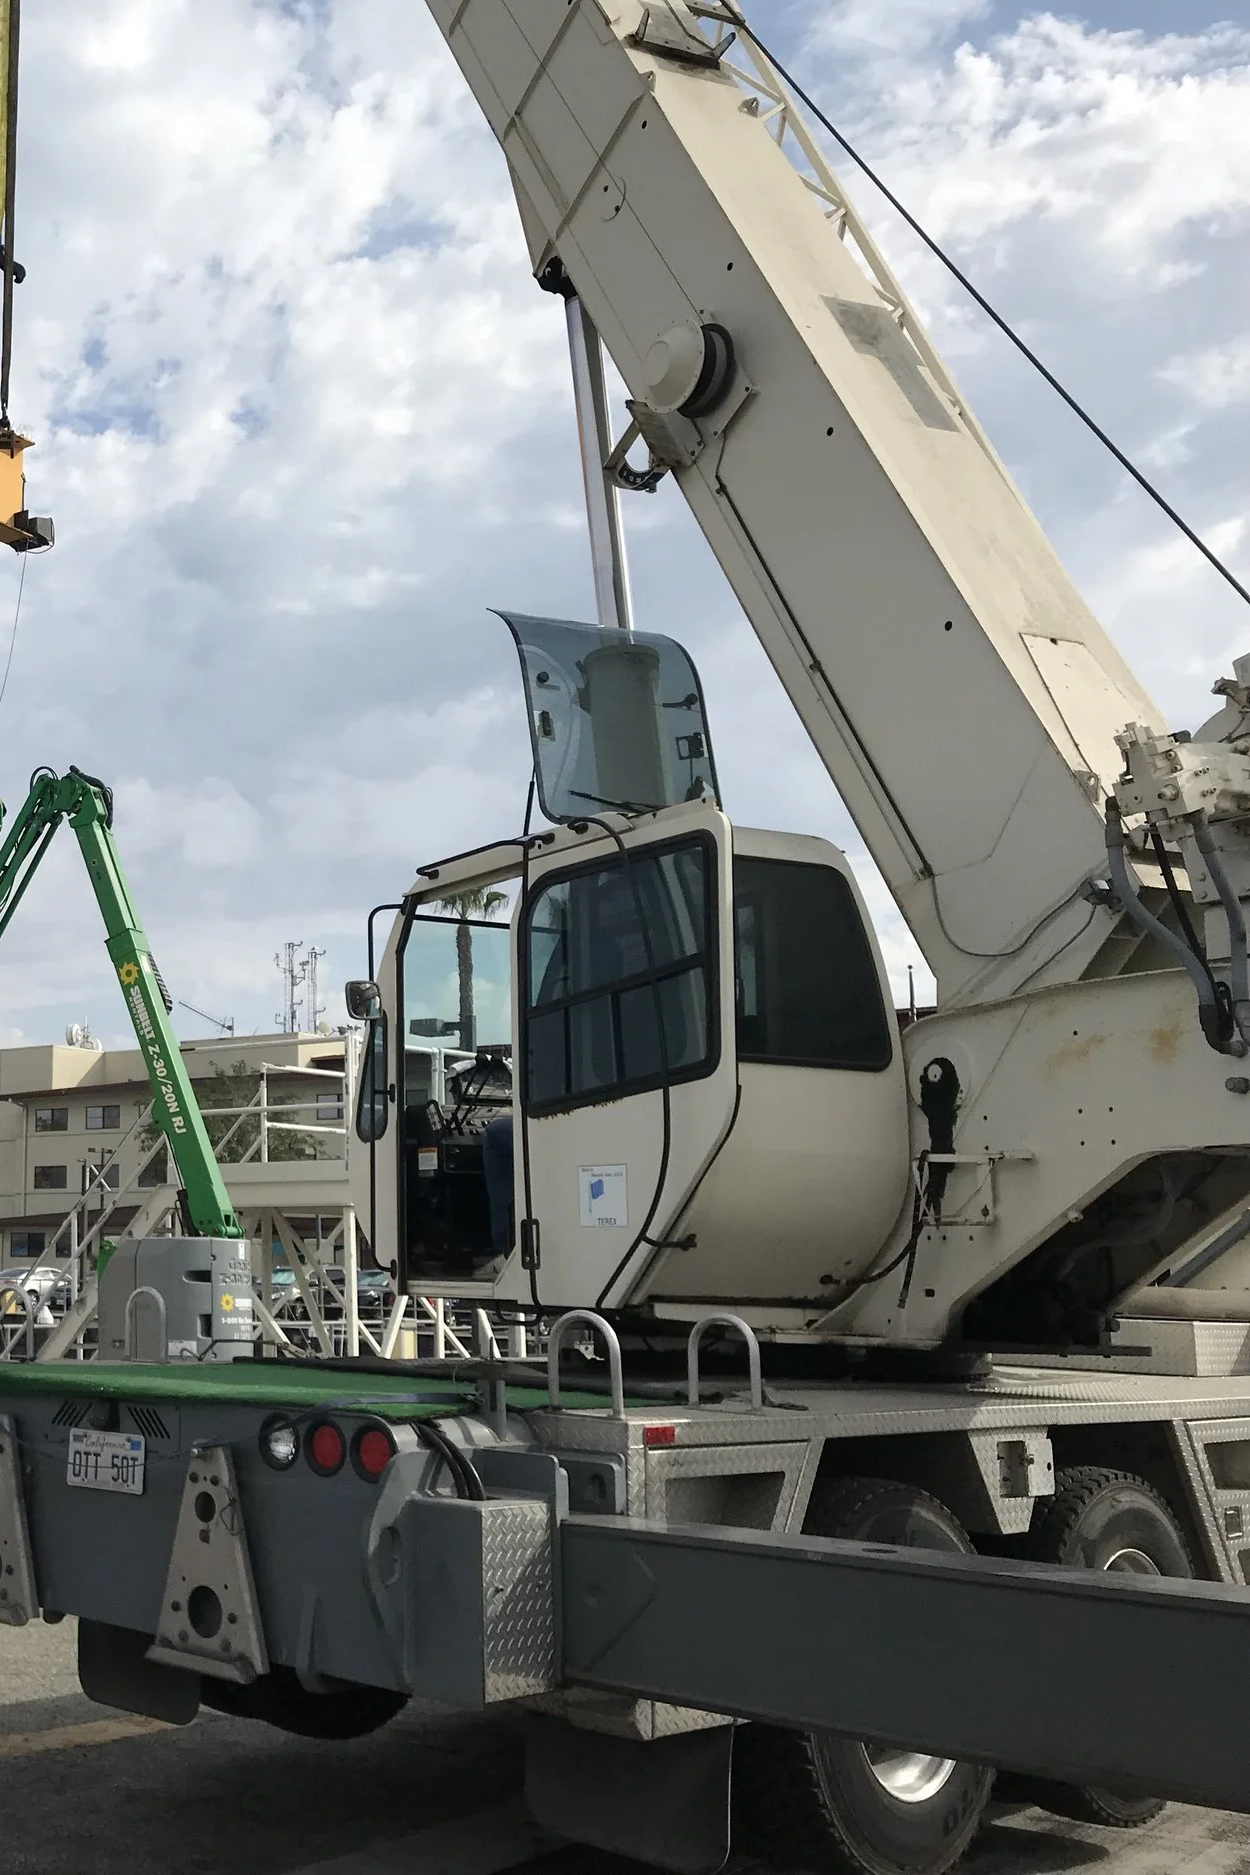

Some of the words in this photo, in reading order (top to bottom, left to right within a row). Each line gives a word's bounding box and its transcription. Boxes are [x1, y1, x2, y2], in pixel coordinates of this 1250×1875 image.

[130, 985, 155, 1039] SUNBELT
[148, 1044, 180, 1113] Z-30/20N
[171, 1116, 188, 1135] RJ
[598, 1217, 617, 1226] TEREX
